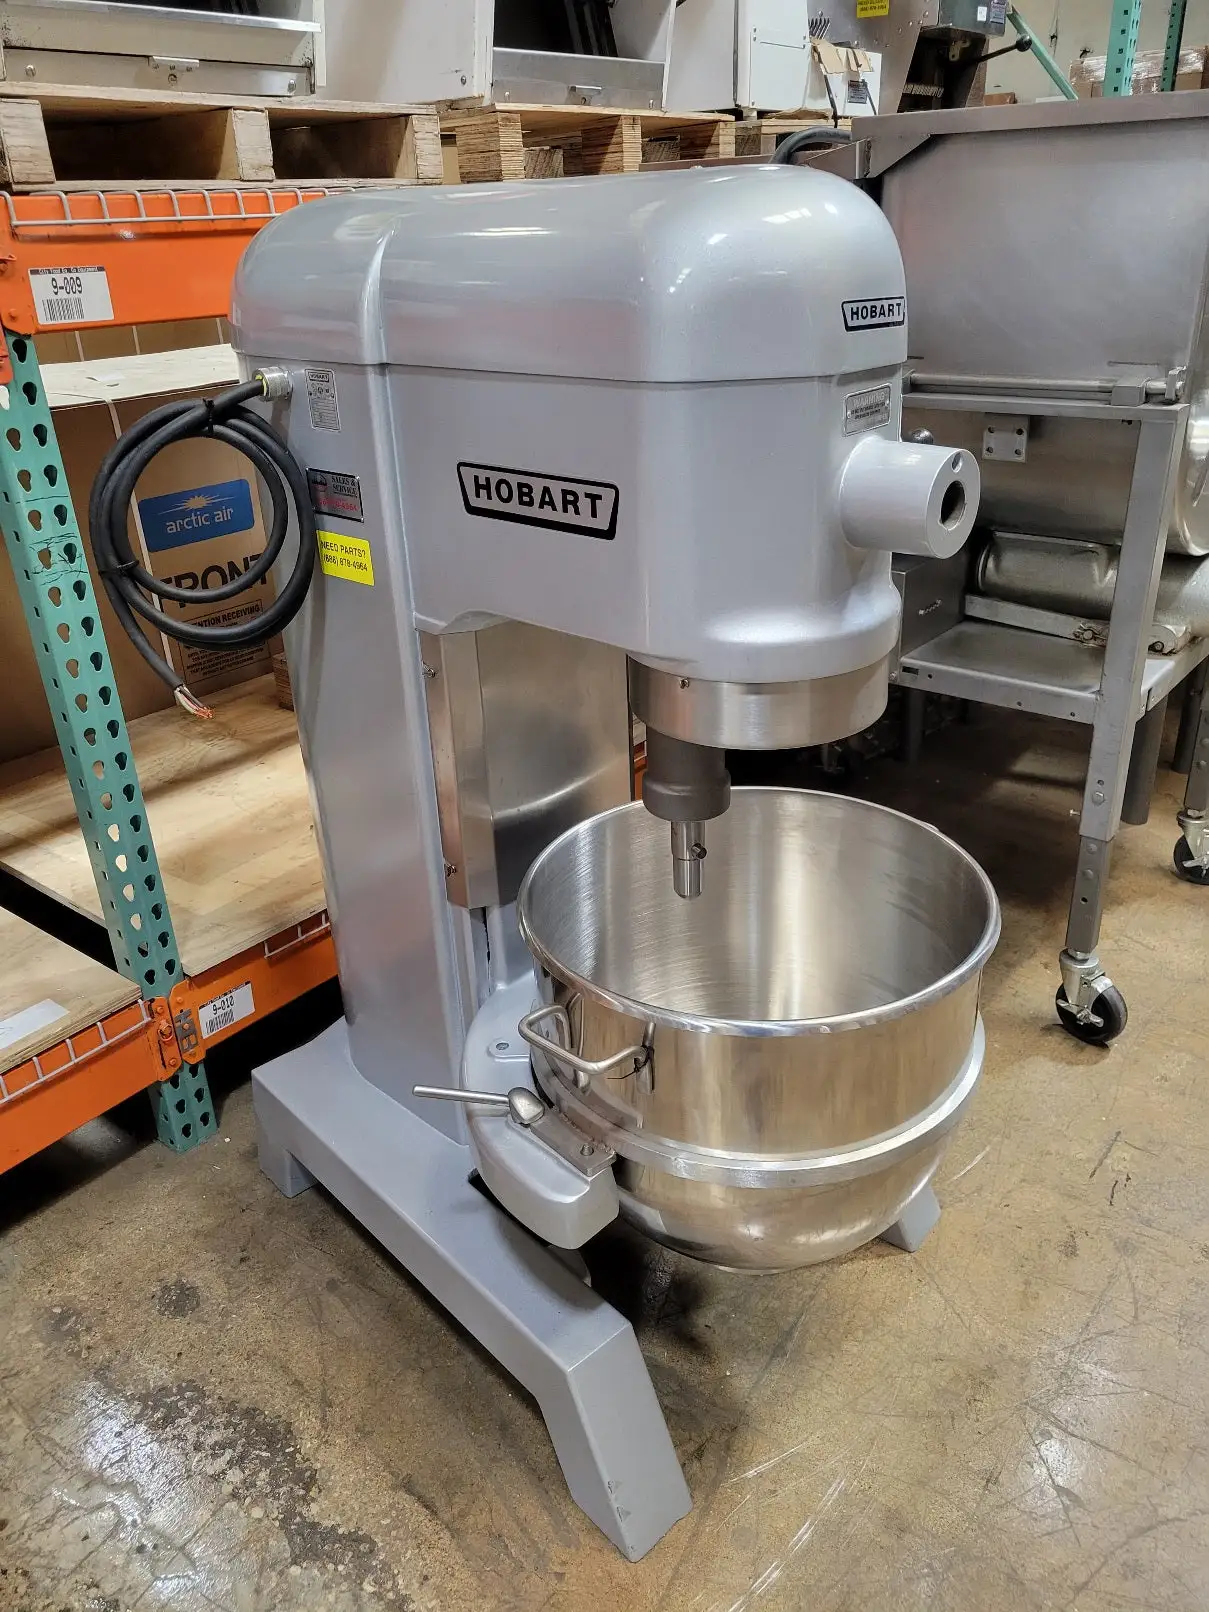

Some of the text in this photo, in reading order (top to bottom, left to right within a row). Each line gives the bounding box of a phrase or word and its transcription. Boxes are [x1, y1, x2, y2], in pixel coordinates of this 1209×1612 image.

[51, 276, 83, 296] 9-009
[850, 302, 902, 321] HOBART
[473, 475, 602, 519] HOBART
[166, 505, 234, 534] arctic air
[320, 540, 366, 559] NEED PARTS?
[221, 604, 261, 622] RECEIVING
